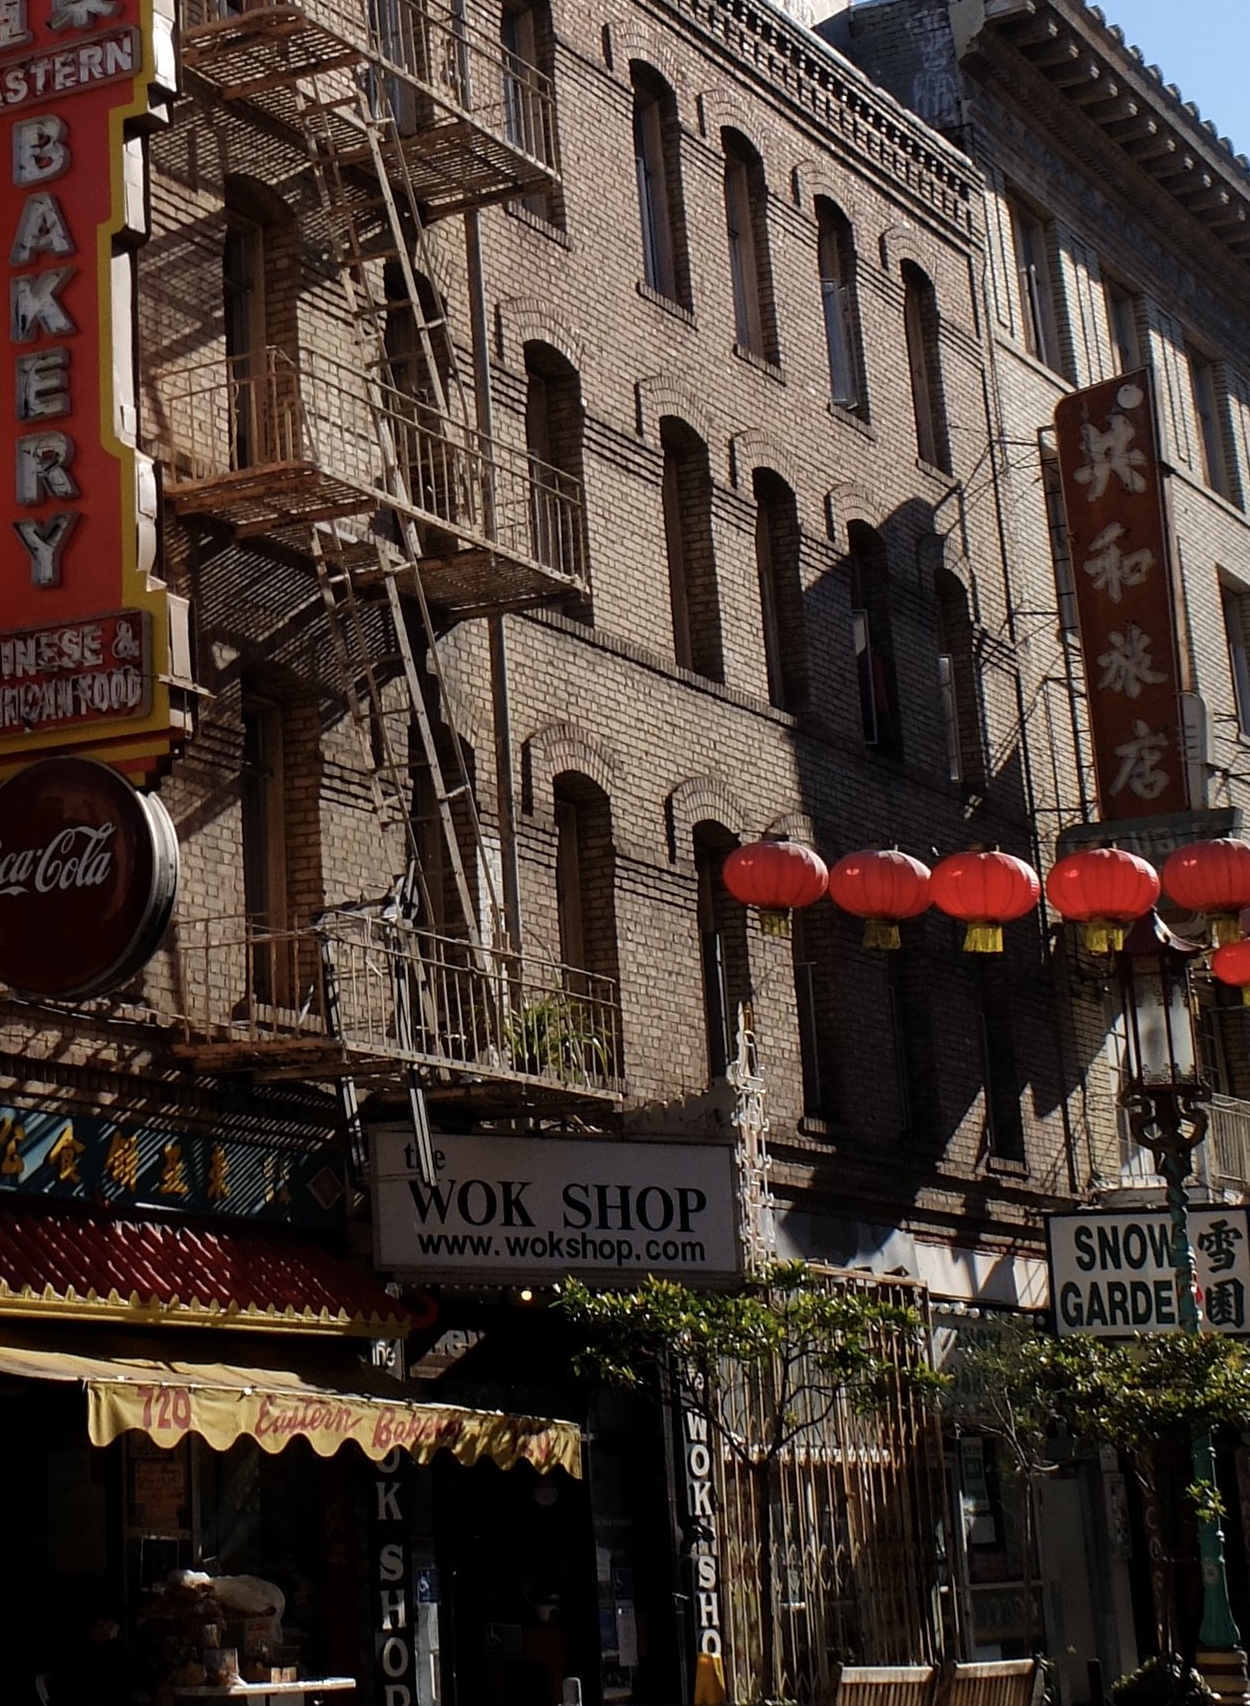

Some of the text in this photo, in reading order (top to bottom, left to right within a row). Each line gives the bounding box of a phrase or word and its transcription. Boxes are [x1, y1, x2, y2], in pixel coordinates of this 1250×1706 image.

[10, 114, 81, 588] BAKERY
[1072, 413, 1169, 799] 共和旅店
[111, 620, 141, 661] &
[75, 665, 143, 716] FOOD
[405, 1142, 447, 1171] te
[408, 1179, 708, 1233] WOK SHOP
[417, 1231, 707, 1266] www.wokshop.com
[1074, 1223, 1179, 1271] SNOW
[1060, 1280, 1177, 1327] GARDE
[137, 1386, 191, 1430] 720
[254, 1394, 364, 1439] Eastern
[685, 1408, 713, 1517] WOK
[697, 1554, 723, 1656] SHO
